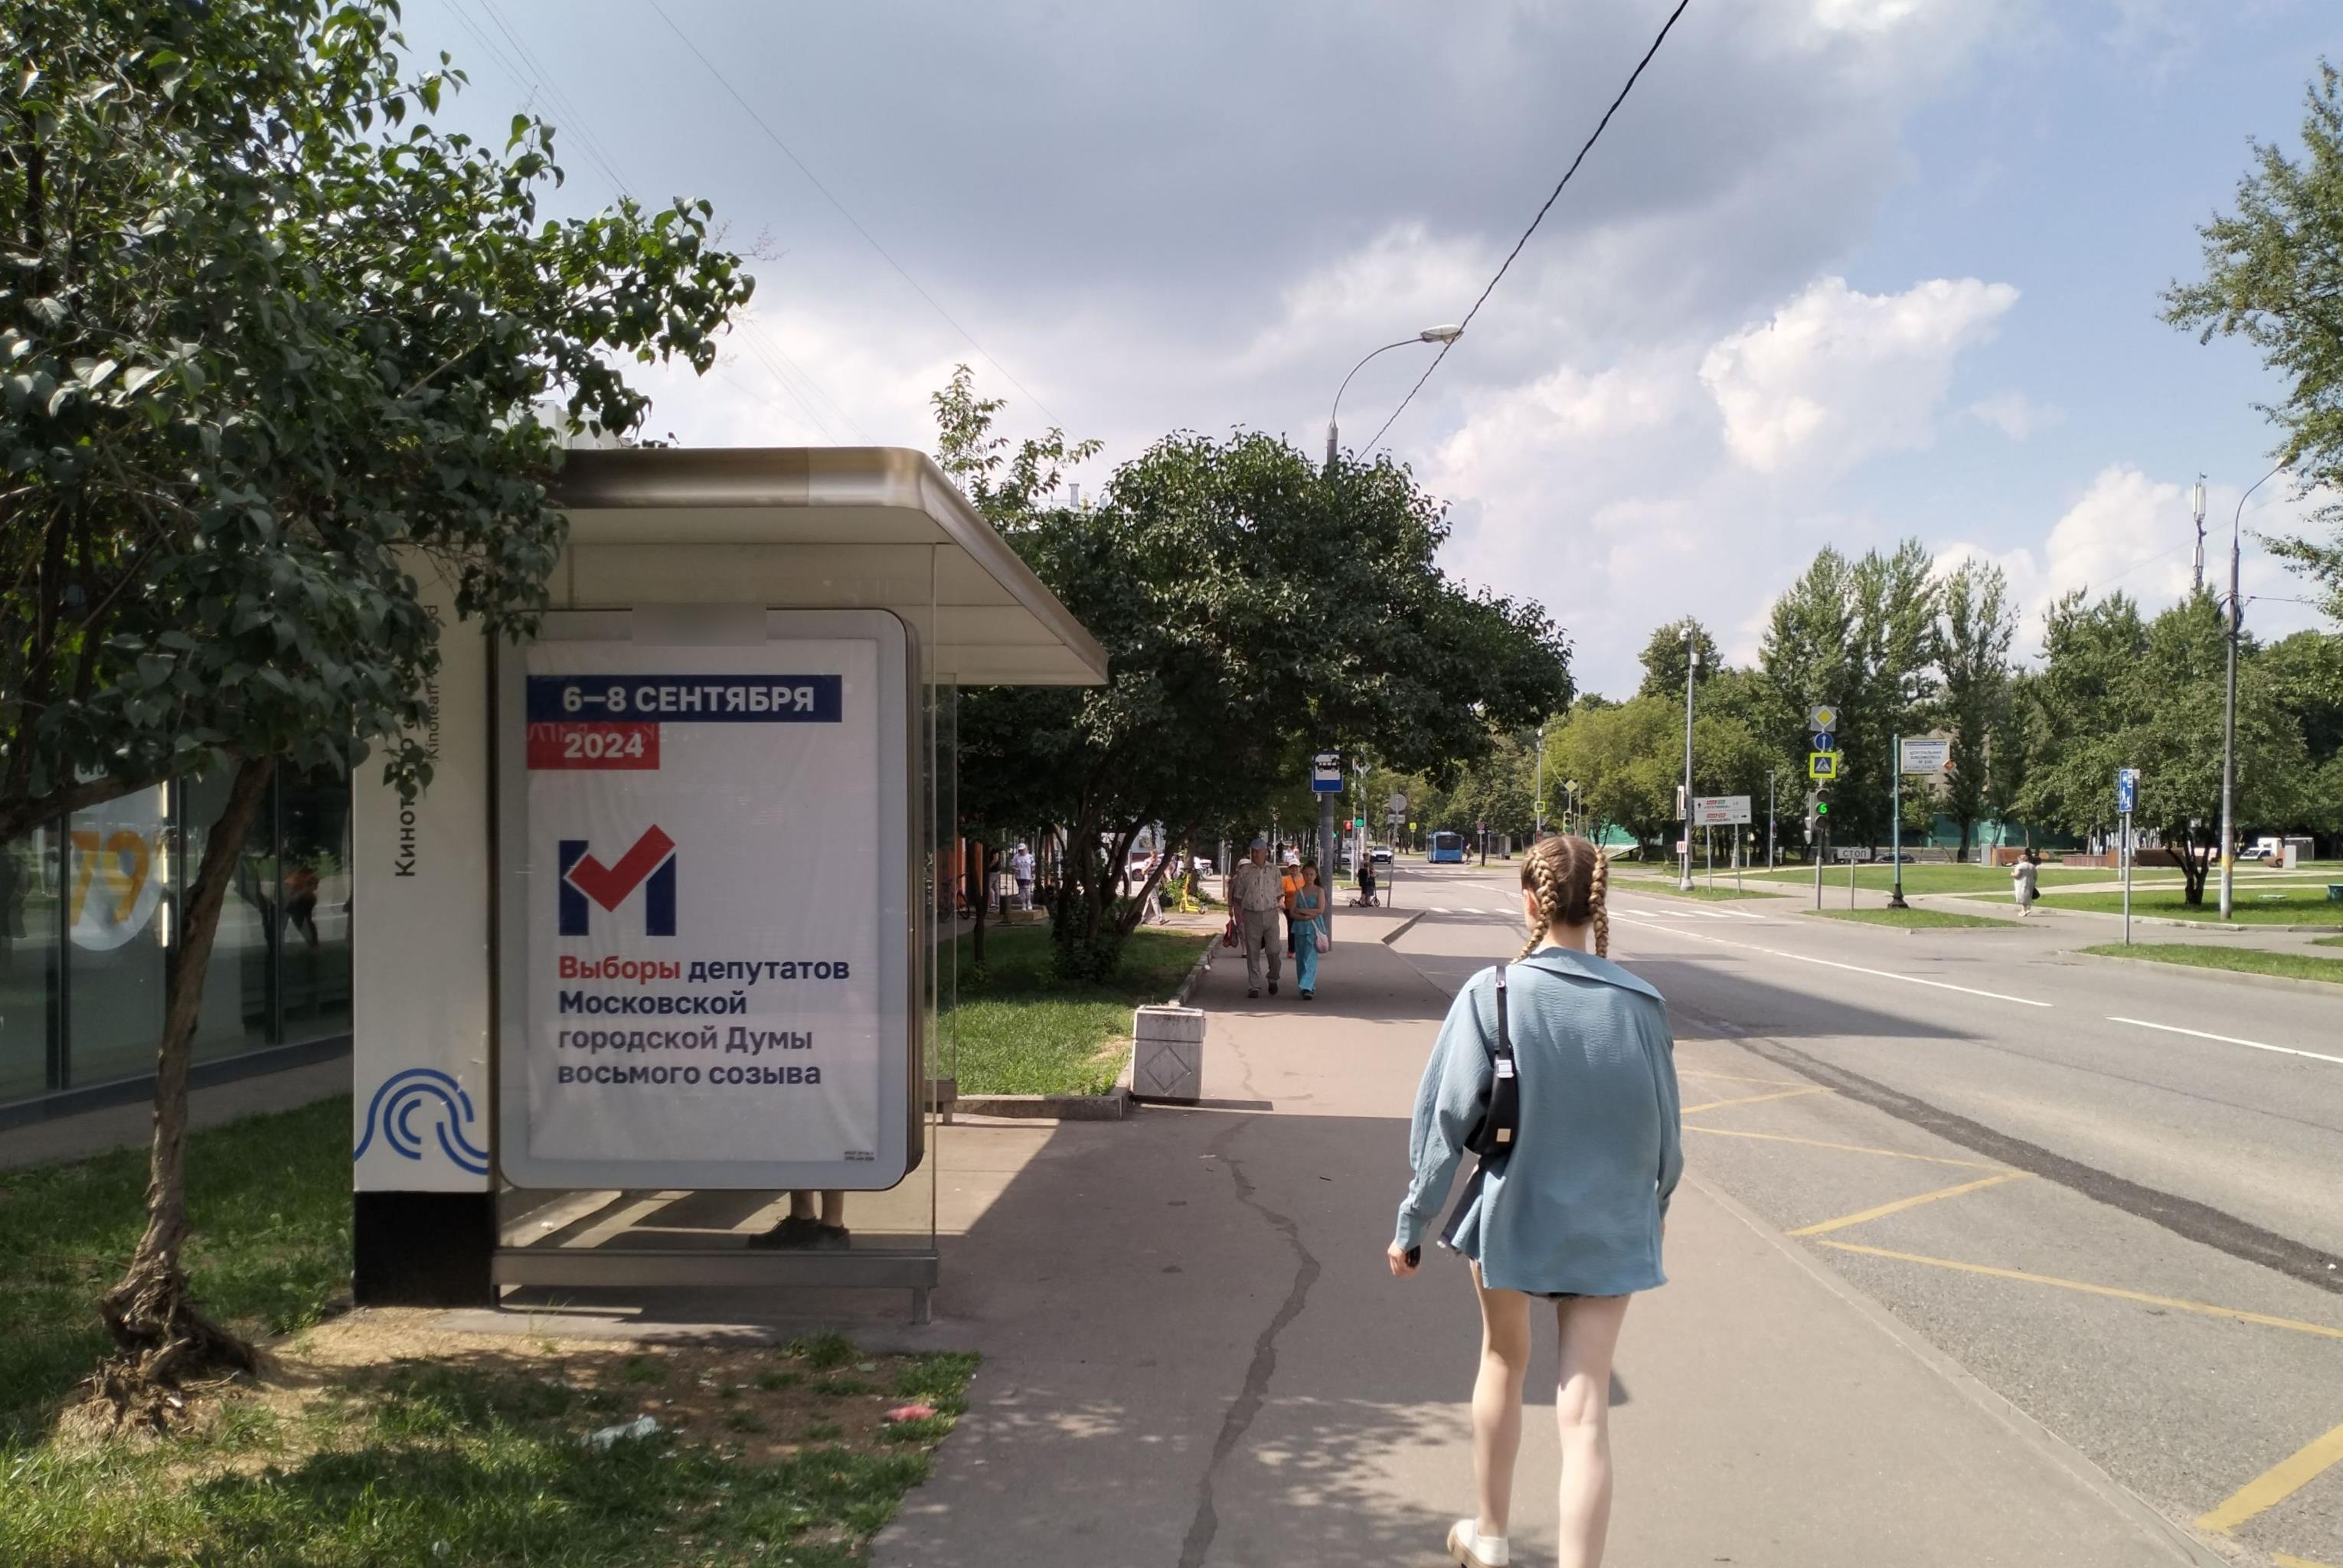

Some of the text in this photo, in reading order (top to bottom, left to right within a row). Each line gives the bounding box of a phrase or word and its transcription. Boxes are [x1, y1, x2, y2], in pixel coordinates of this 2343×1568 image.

[635, 686, 815, 712] СЕНТЯБРЯ
[564, 733, 645, 759] 2024
[1842, 850, 1867, 858] СТОП
[558, 956, 850, 985] Выборы депутатов
[559, 990, 747, 1014] Московской
[559, 1026, 812, 1055] городской Думы
[558, 1066, 822, 1085] восьмого созыва
